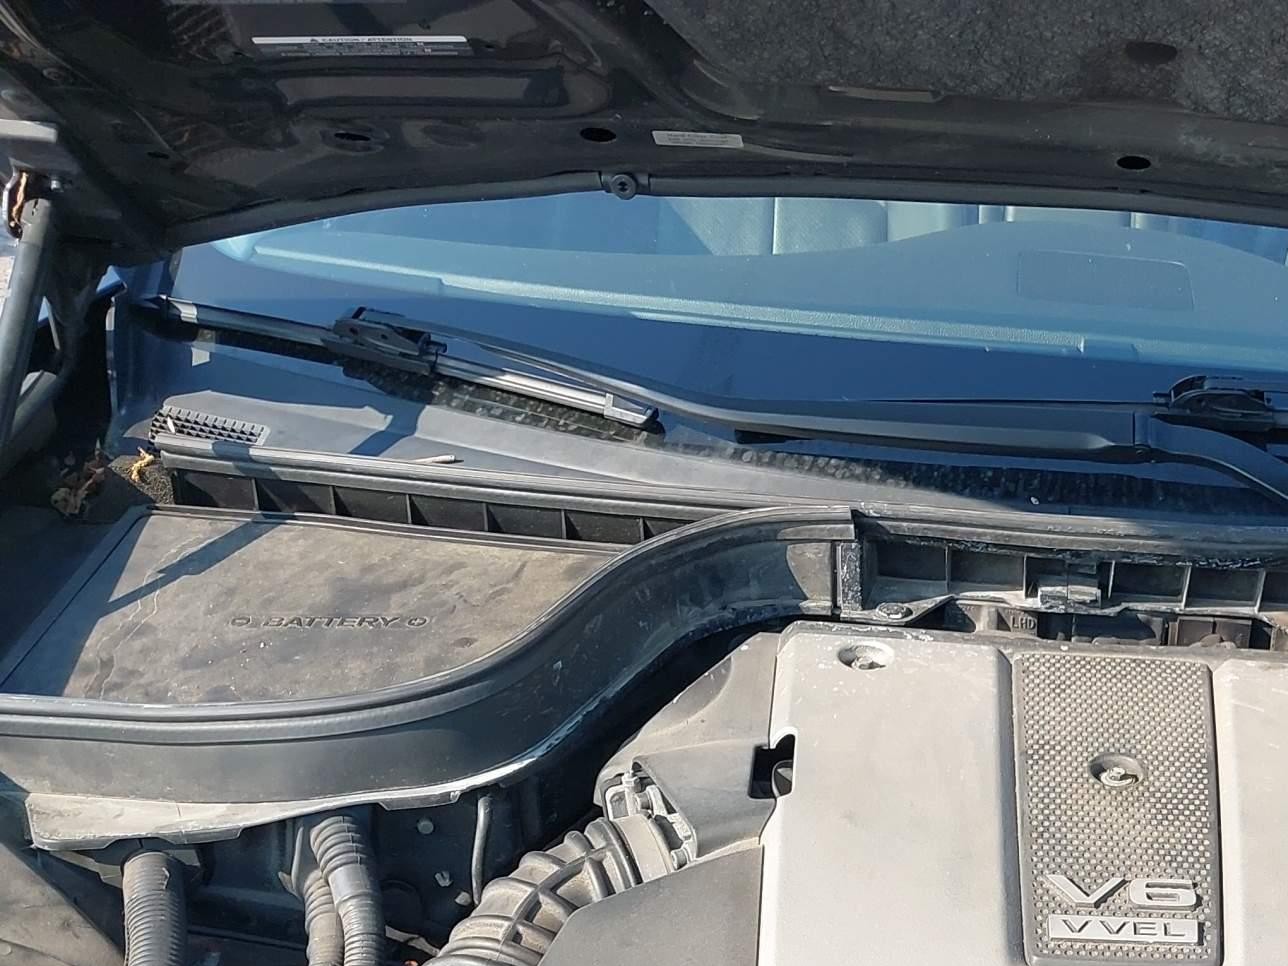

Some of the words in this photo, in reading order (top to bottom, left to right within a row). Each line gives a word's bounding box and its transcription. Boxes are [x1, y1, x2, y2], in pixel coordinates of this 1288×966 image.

[263, 616, 400, 629] BATTERY
[1011, 614, 1036, 631] LHD
[1046, 875, 1198, 909] V6
[1062, 919, 1186, 938] VVEL
